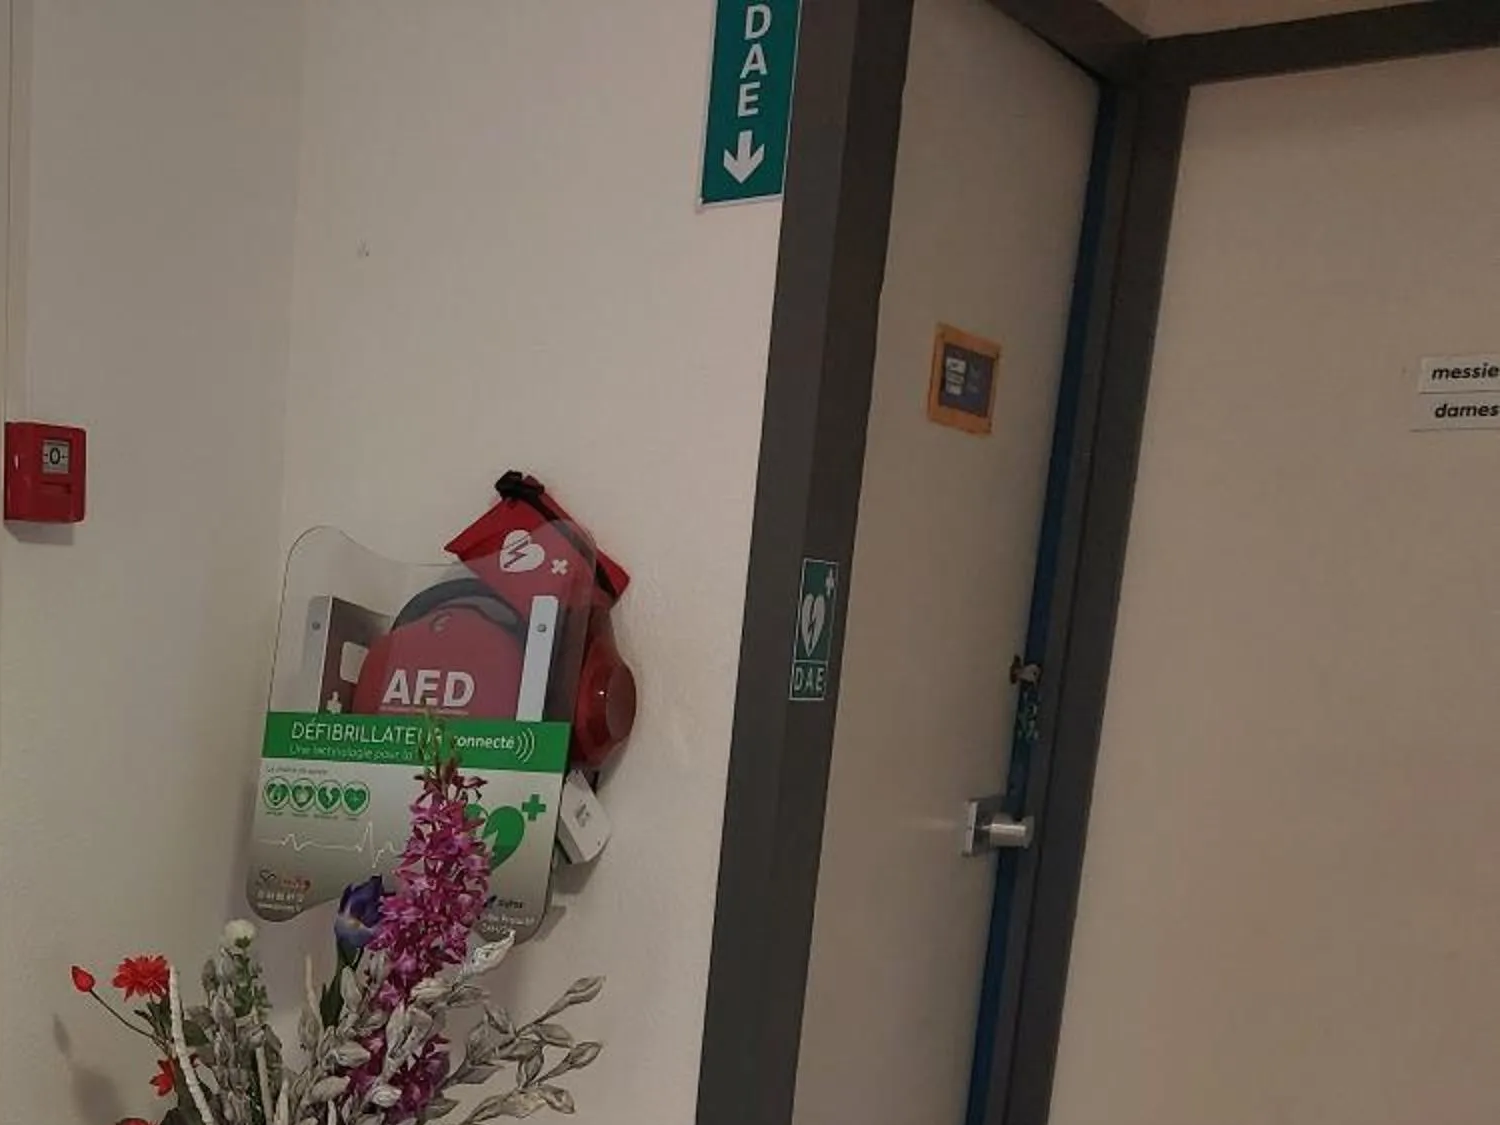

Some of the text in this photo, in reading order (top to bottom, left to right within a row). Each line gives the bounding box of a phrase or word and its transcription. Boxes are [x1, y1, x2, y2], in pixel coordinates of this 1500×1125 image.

[737, 4, 772, 118] DAE
[1435, 402, 1499, 418] dames
[382, 669, 476, 708] AED
[793, 667, 825, 691] DAE
[453, 734, 516, 749] onnecté
